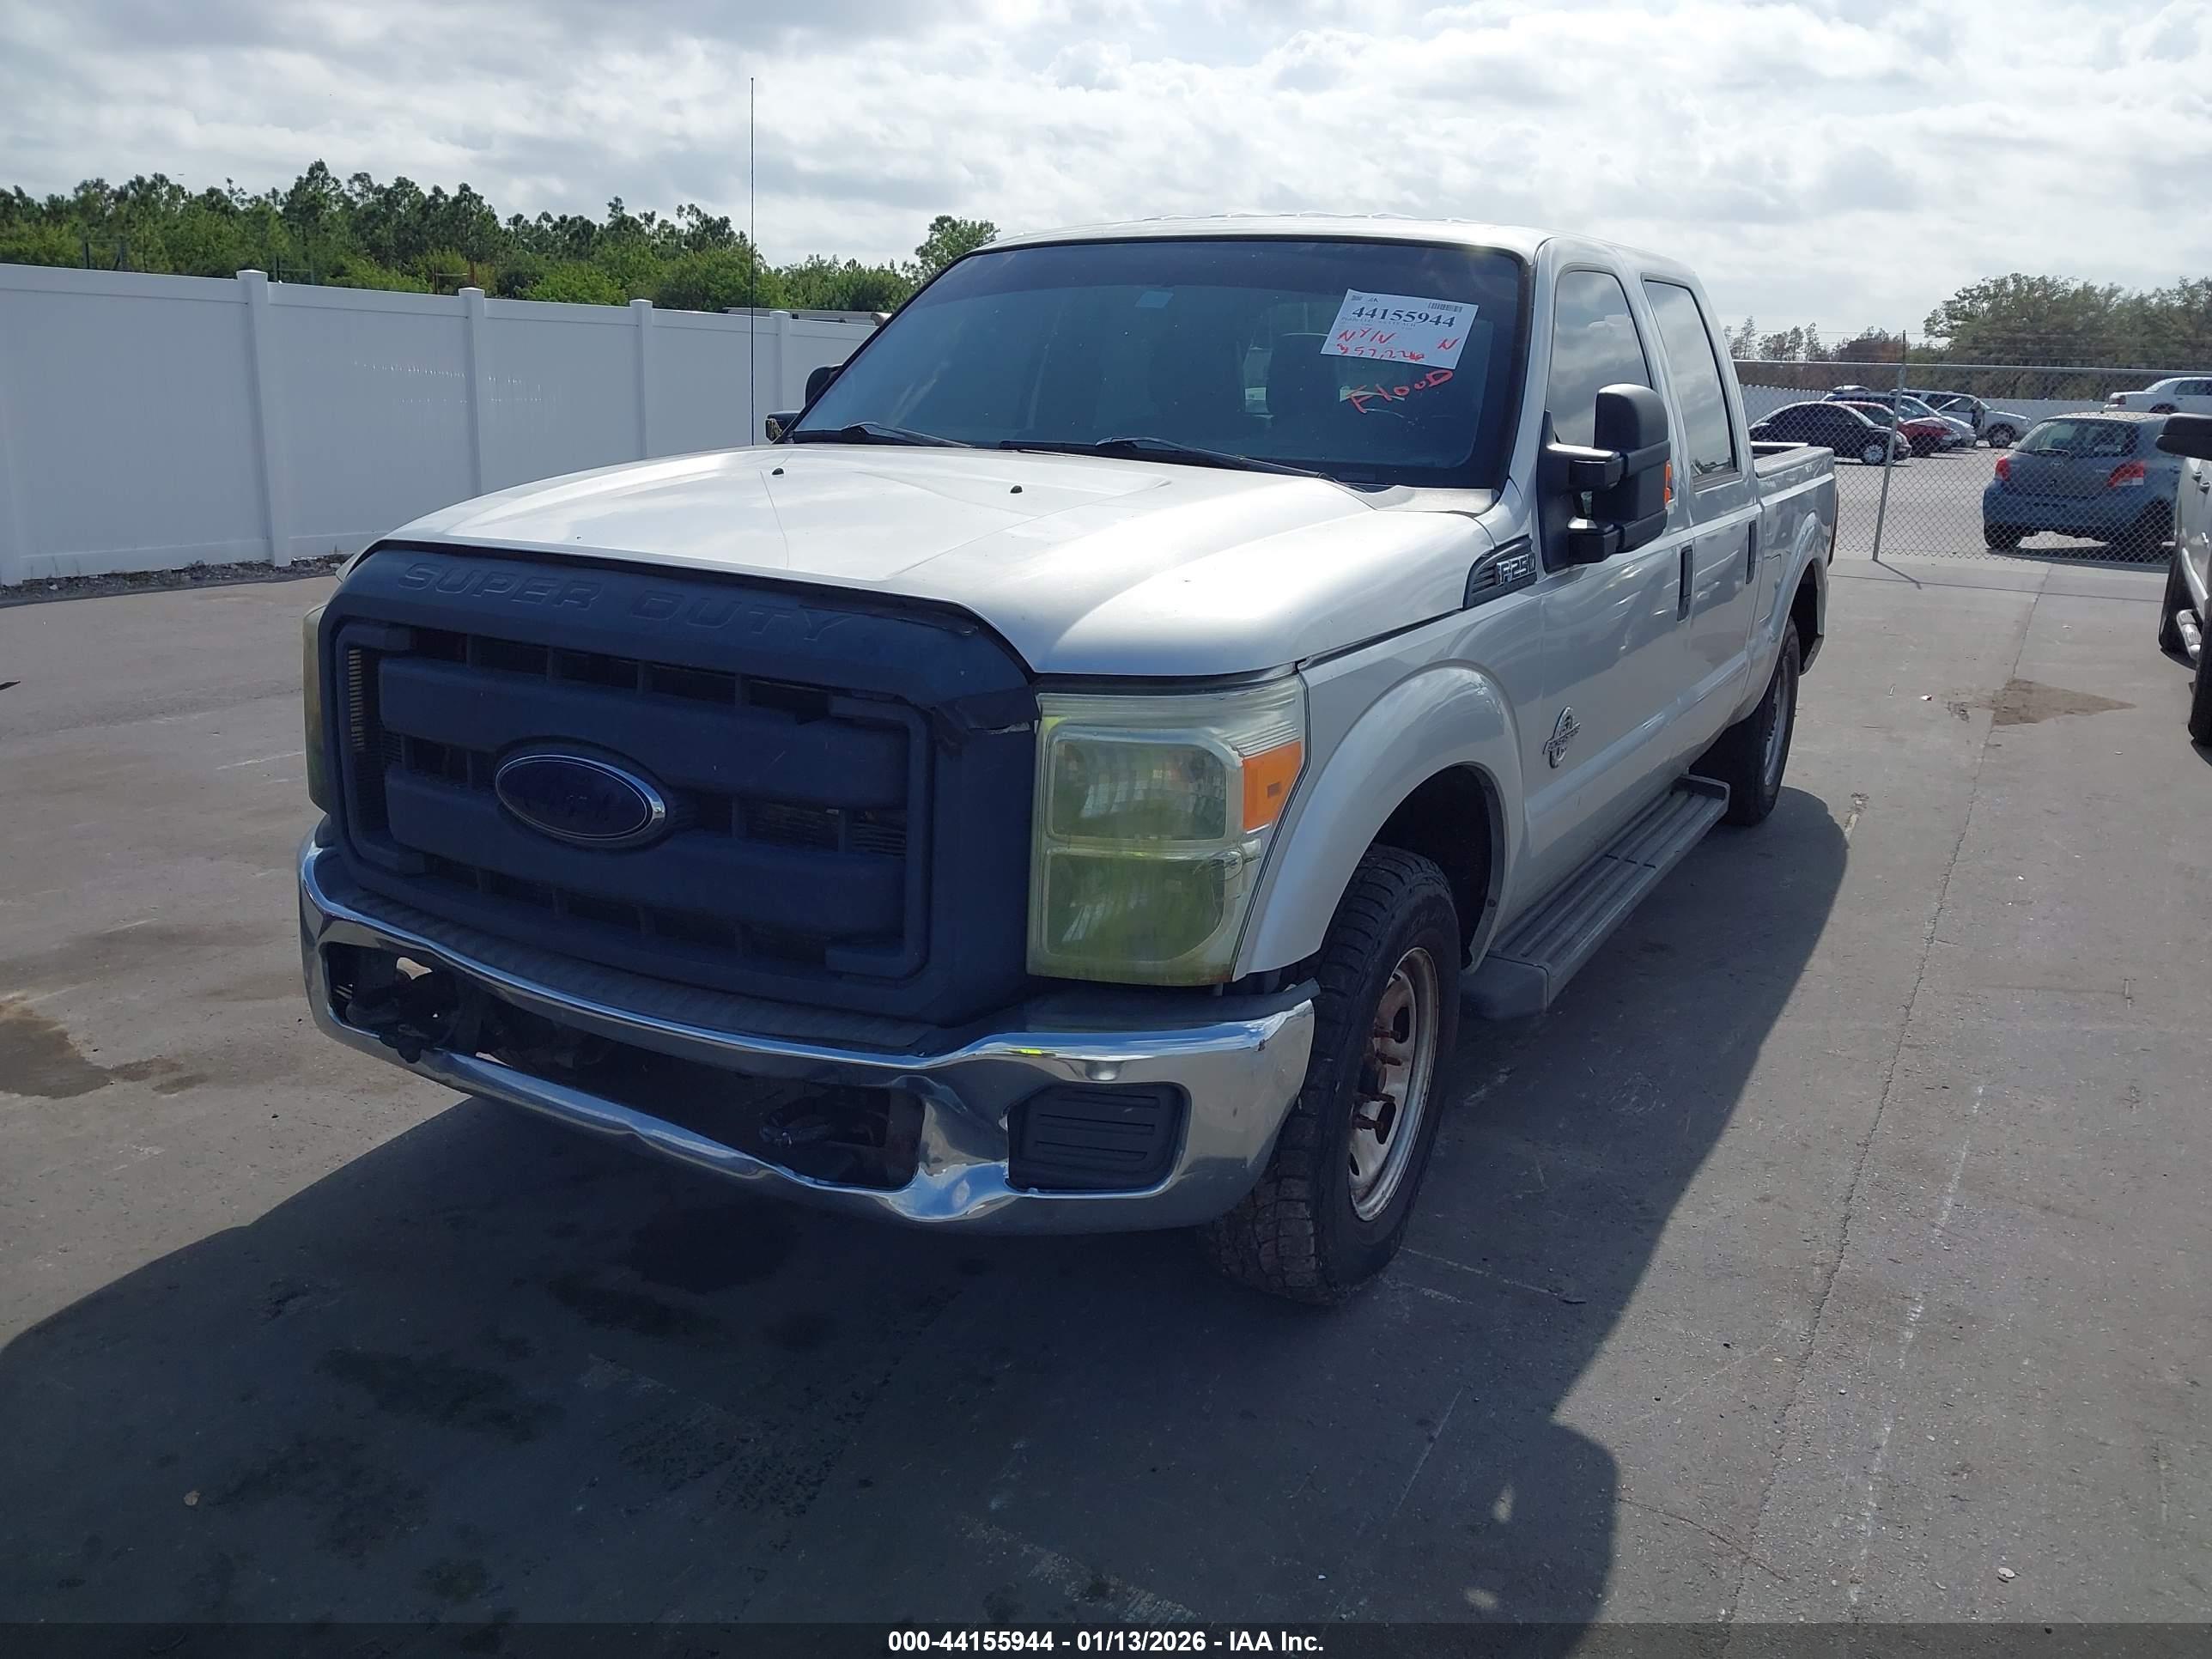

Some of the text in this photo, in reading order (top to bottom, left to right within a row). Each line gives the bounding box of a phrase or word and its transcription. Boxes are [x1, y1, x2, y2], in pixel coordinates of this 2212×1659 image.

[1352, 307, 1455, 327] 44155944
[398, 562, 853, 641] SUPER DUTY
